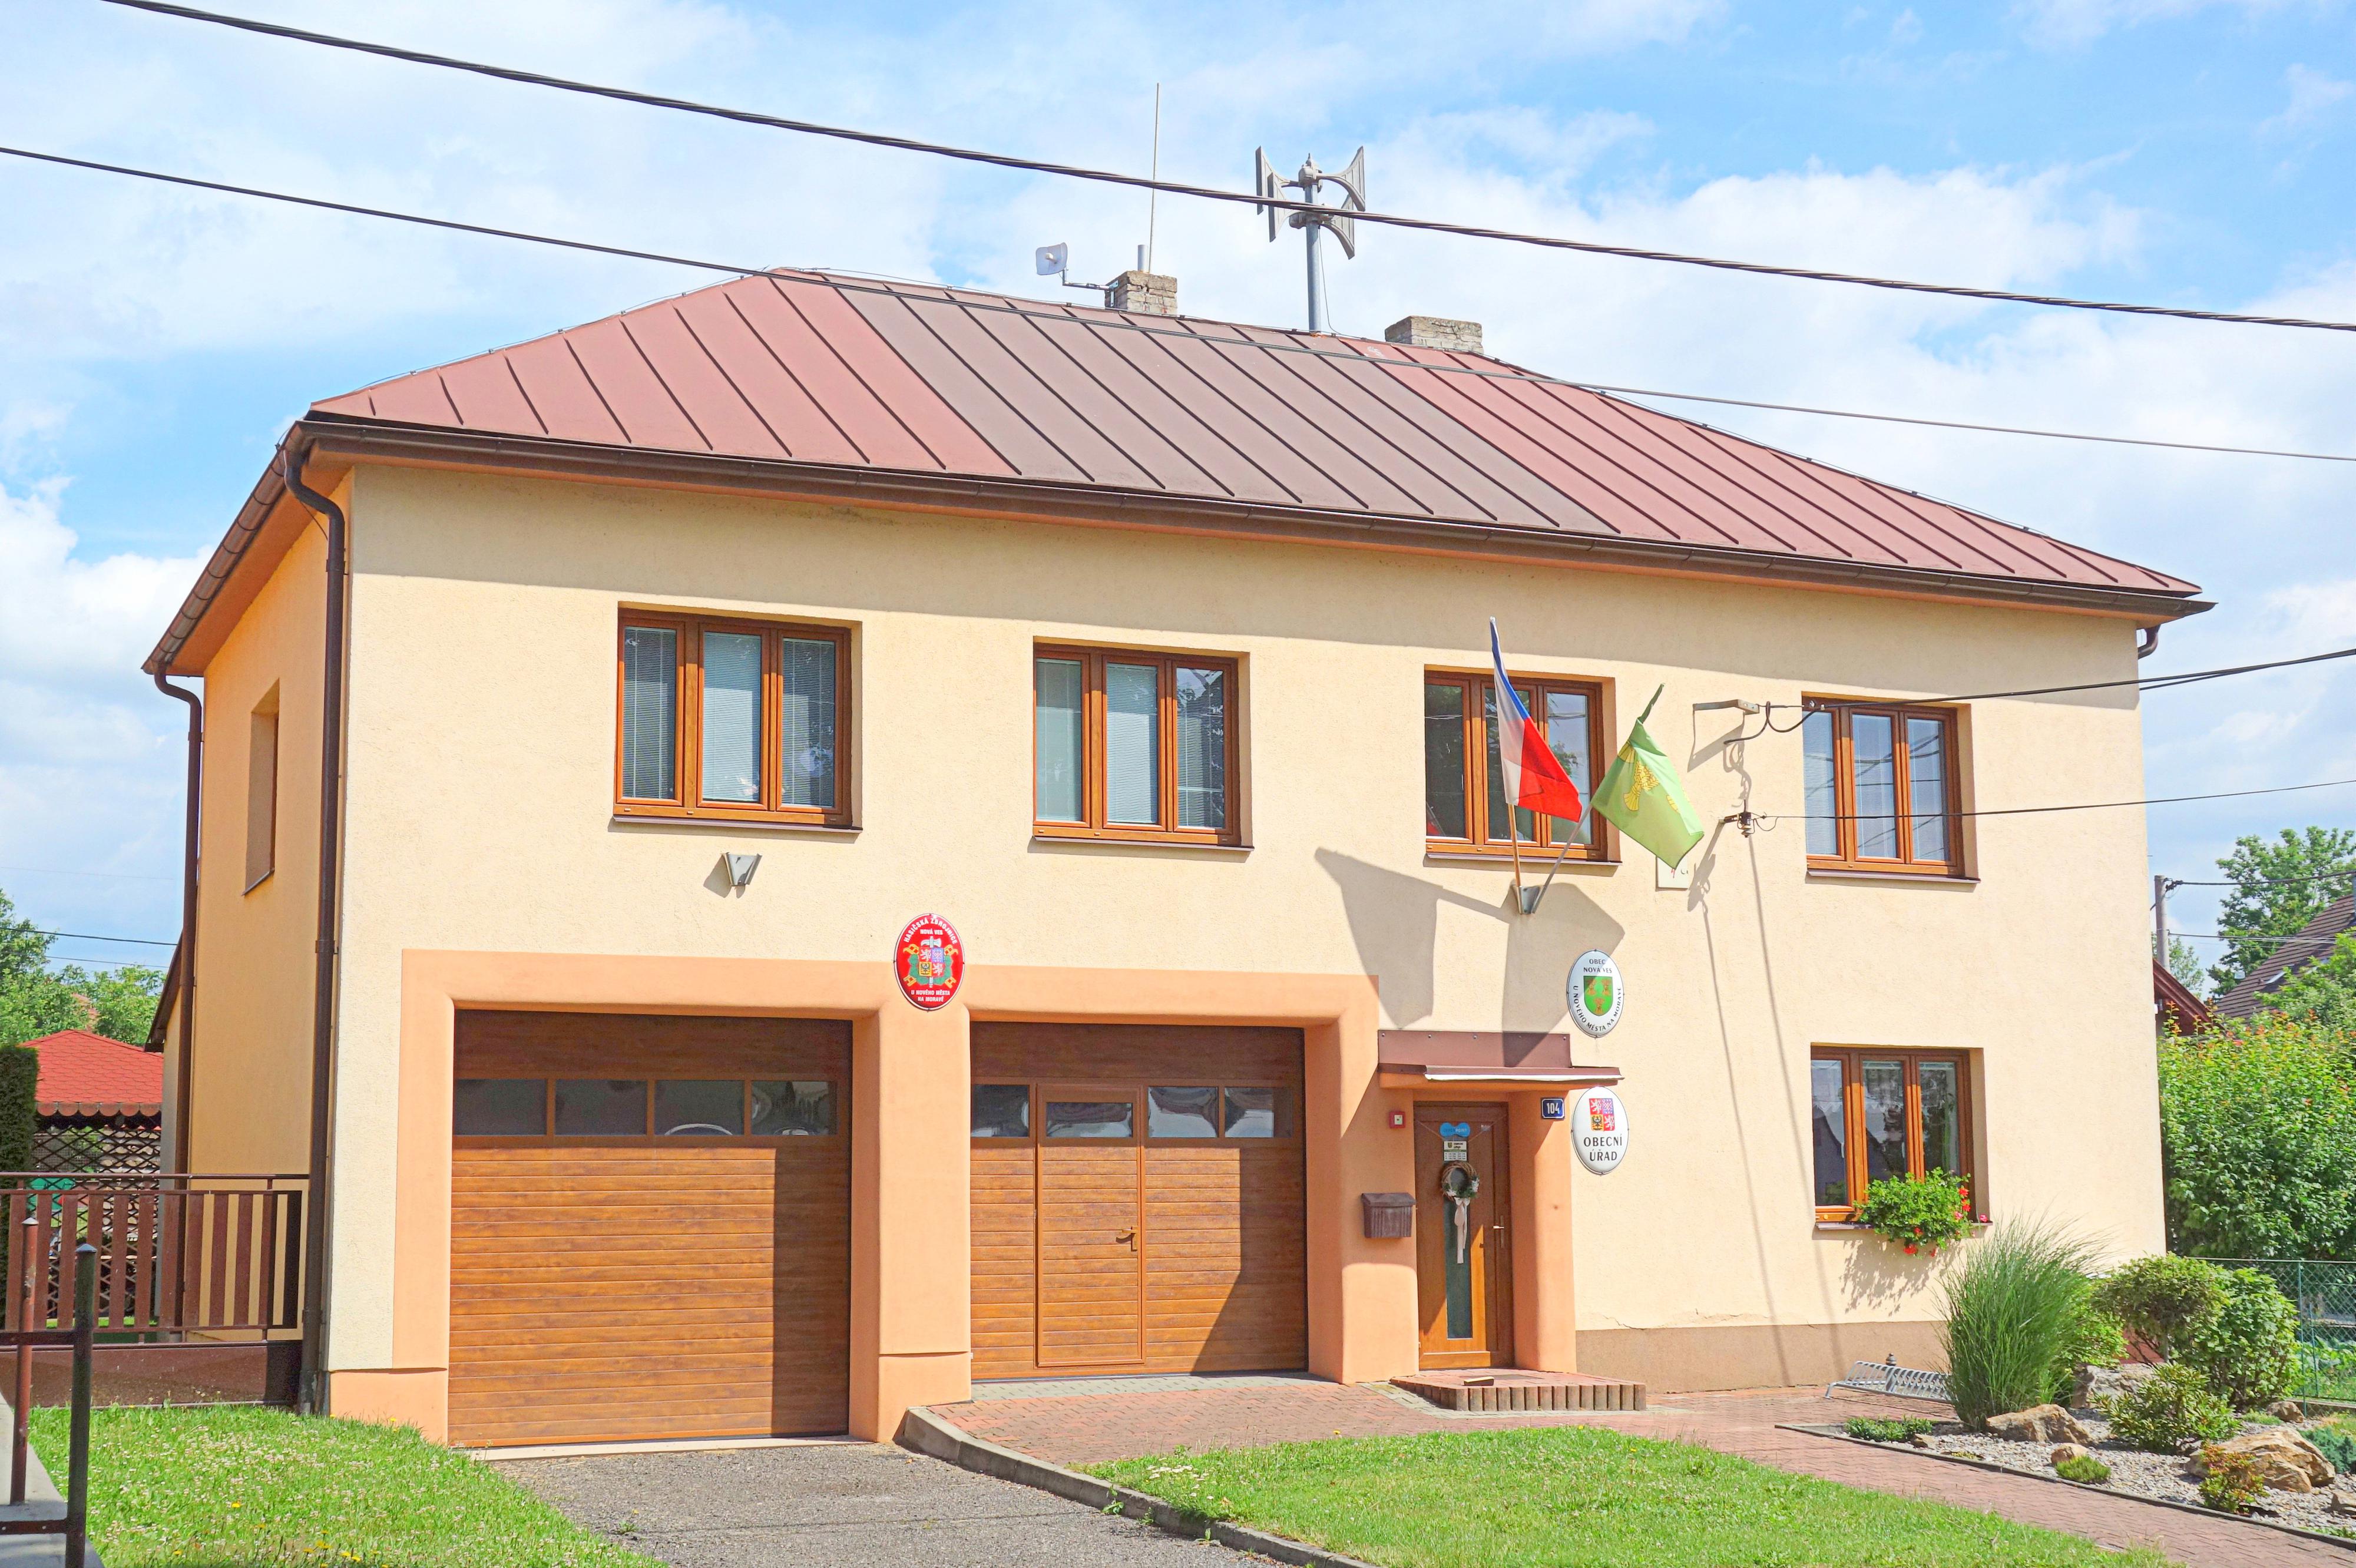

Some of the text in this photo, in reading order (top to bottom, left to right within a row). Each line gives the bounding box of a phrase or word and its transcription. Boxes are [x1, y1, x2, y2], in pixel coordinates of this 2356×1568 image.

[904, 917, 958, 944] HASIČSKÁ ZBROJNICE
[1573, 993, 1587, 1023] NOVÉHO
[1587, 1022, 1606, 1031] MĚSTA
[1607, 1018, 1614, 1027] NA
[1547, 1102, 1560, 1114] 104
[1583, 1134, 1622, 1147] OBECNÍ
[1590, 1149, 1617, 1162] ÚŘAD
